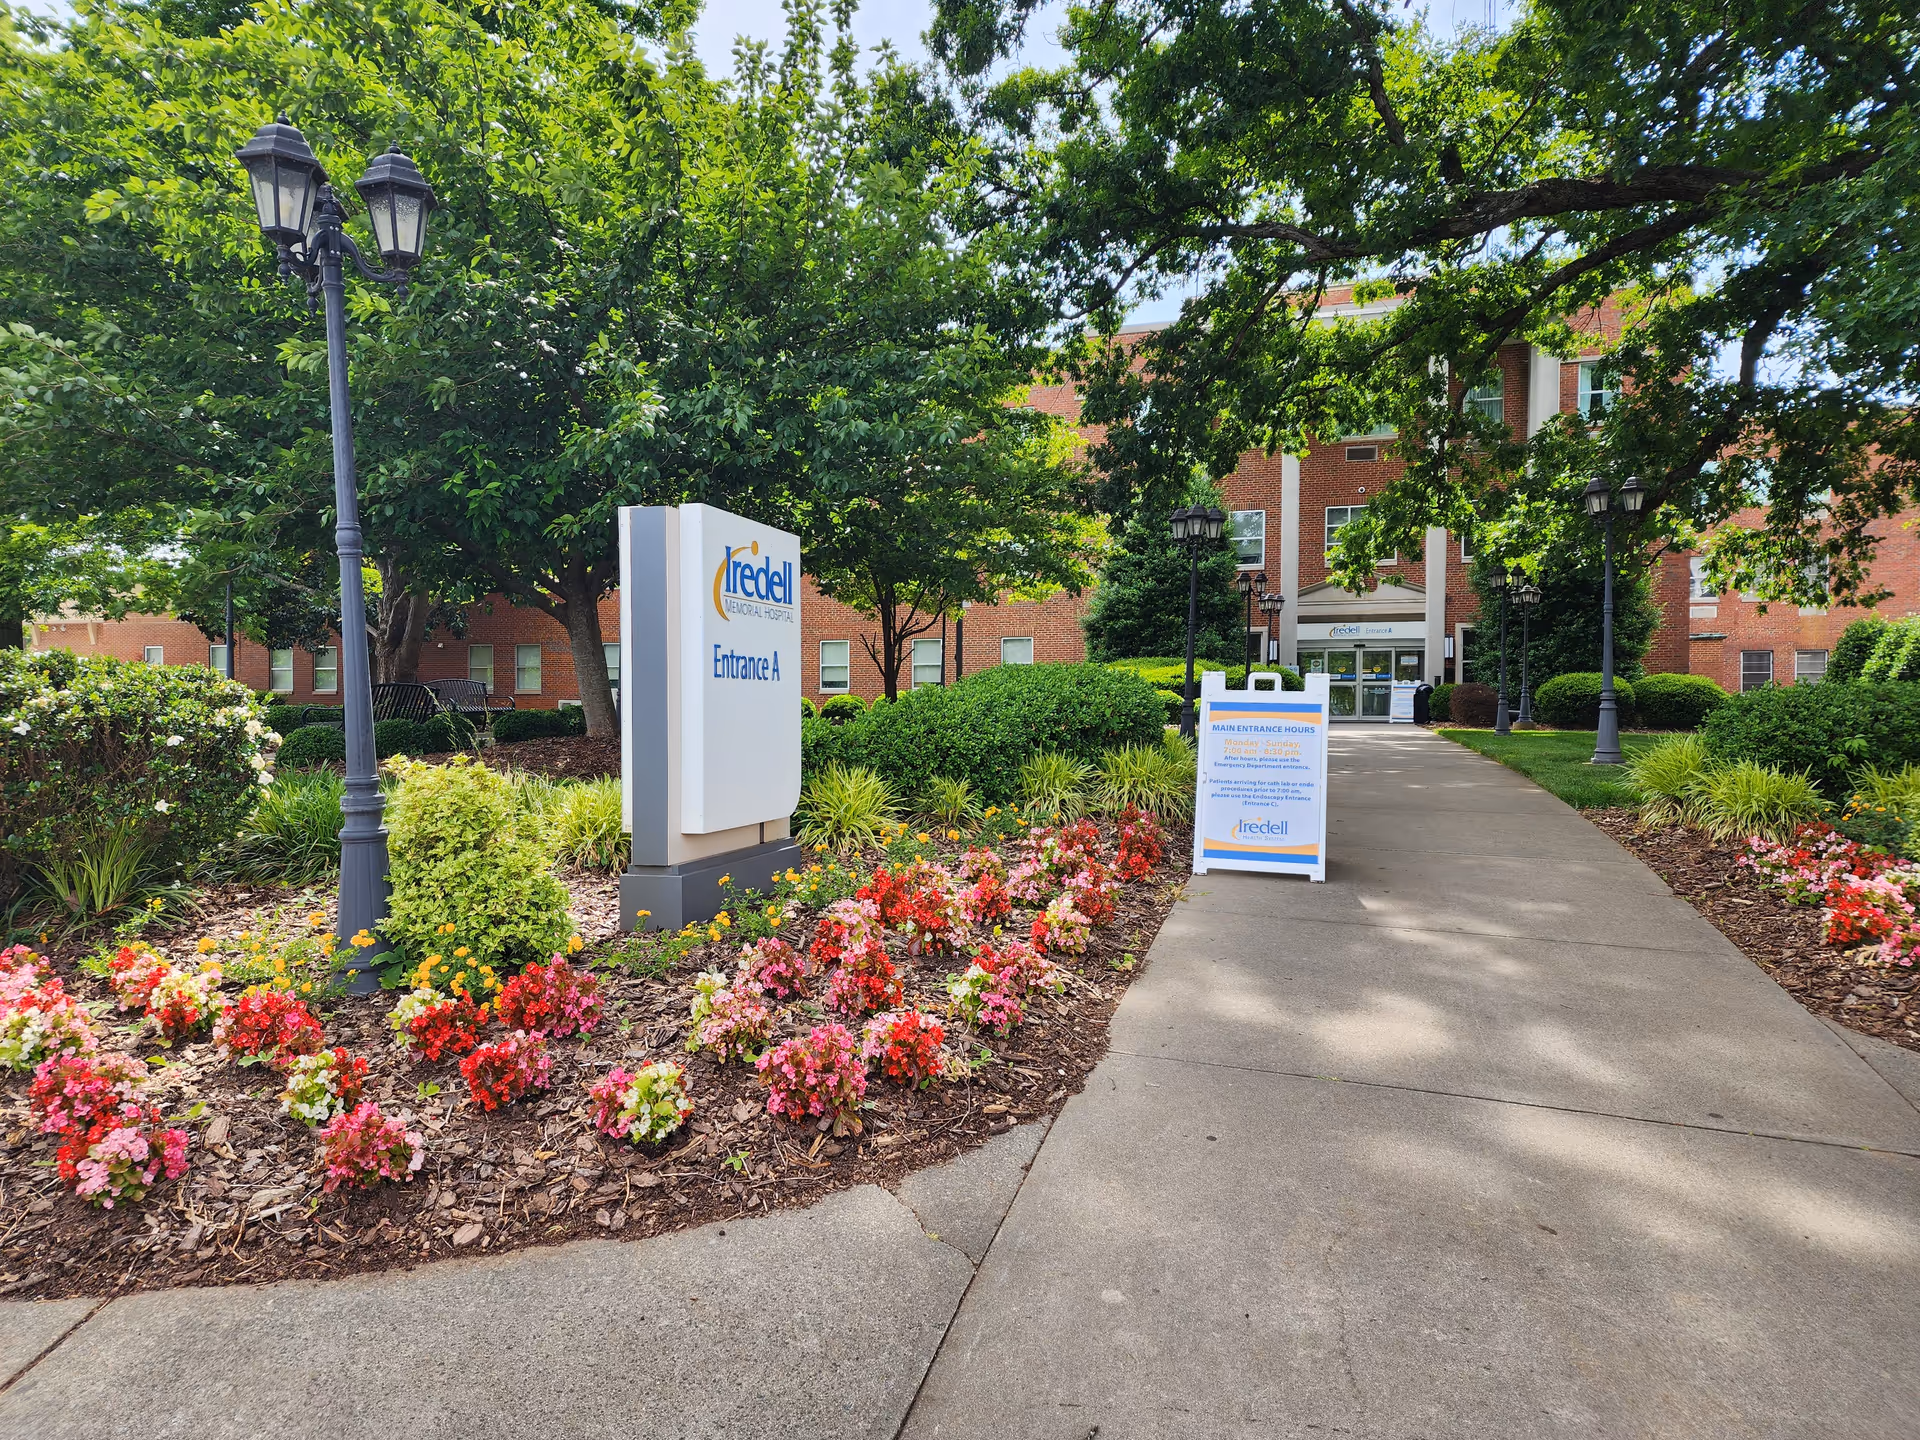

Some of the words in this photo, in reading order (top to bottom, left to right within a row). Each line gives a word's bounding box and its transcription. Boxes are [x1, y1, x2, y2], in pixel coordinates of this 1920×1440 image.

[725, 545, 793, 605] Iredell
[724, 598, 763, 618] MEMORIAL
[764, 606, 794, 623] HOSPITAL
[1333, 626, 1360, 634] Iredell
[713, 644, 769, 681] Entrance
[771, 651, 780, 682] A
[1212, 724, 1235, 732] MAIN
[1237, 725, 1283, 733] ENTRANCE
[1284, 726, 1315, 734] HOURS
[1224, 739, 1259, 747] Monday
[1238, 819, 1288, 835] Iredell
